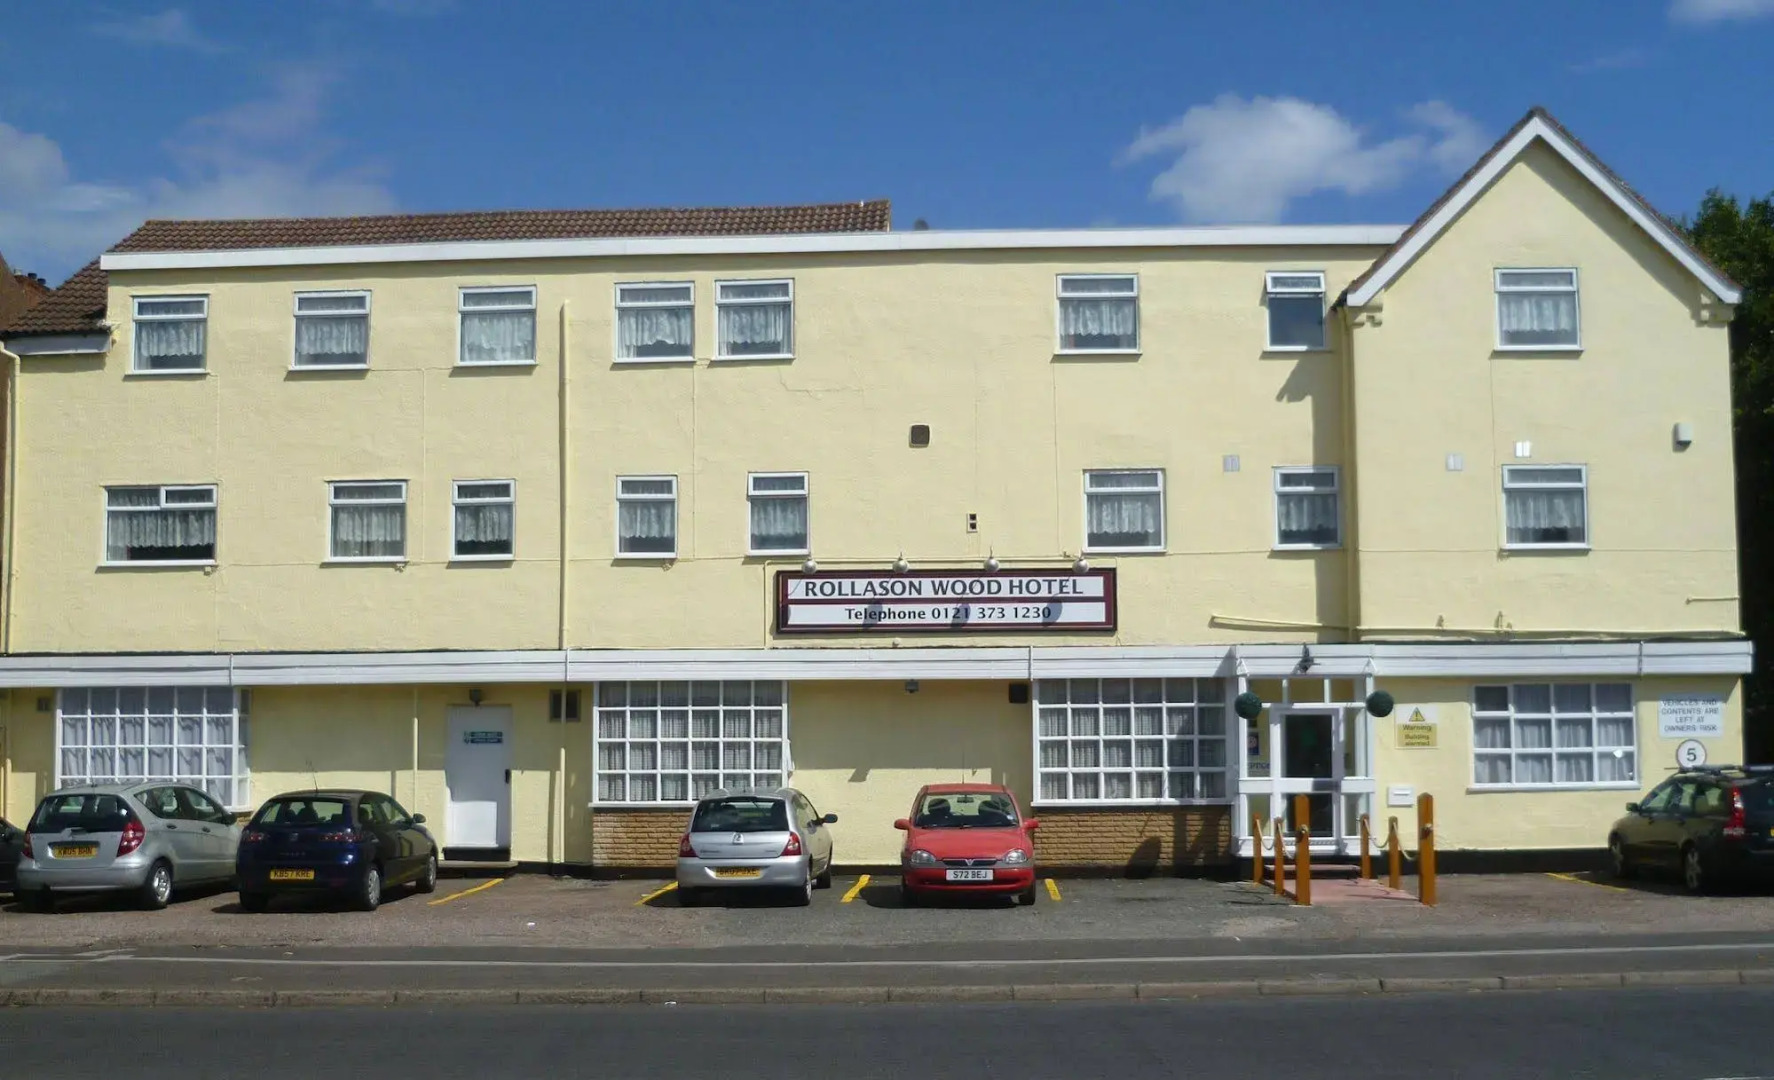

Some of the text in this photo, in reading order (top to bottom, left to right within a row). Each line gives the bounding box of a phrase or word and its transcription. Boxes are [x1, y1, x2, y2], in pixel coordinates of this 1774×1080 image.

[804, 579, 1083, 597] ROLLASON WOOD HOTEL
[845, 606, 1052, 622] Telephone 0121 373 1230
[1662, 698, 1717, 706] VEHICLES AND
[1661, 707, 1702, 715] CONTENTS
[1686, 747, 1697, 762] 5
[953, 869, 988, 879] S72 BEJ
